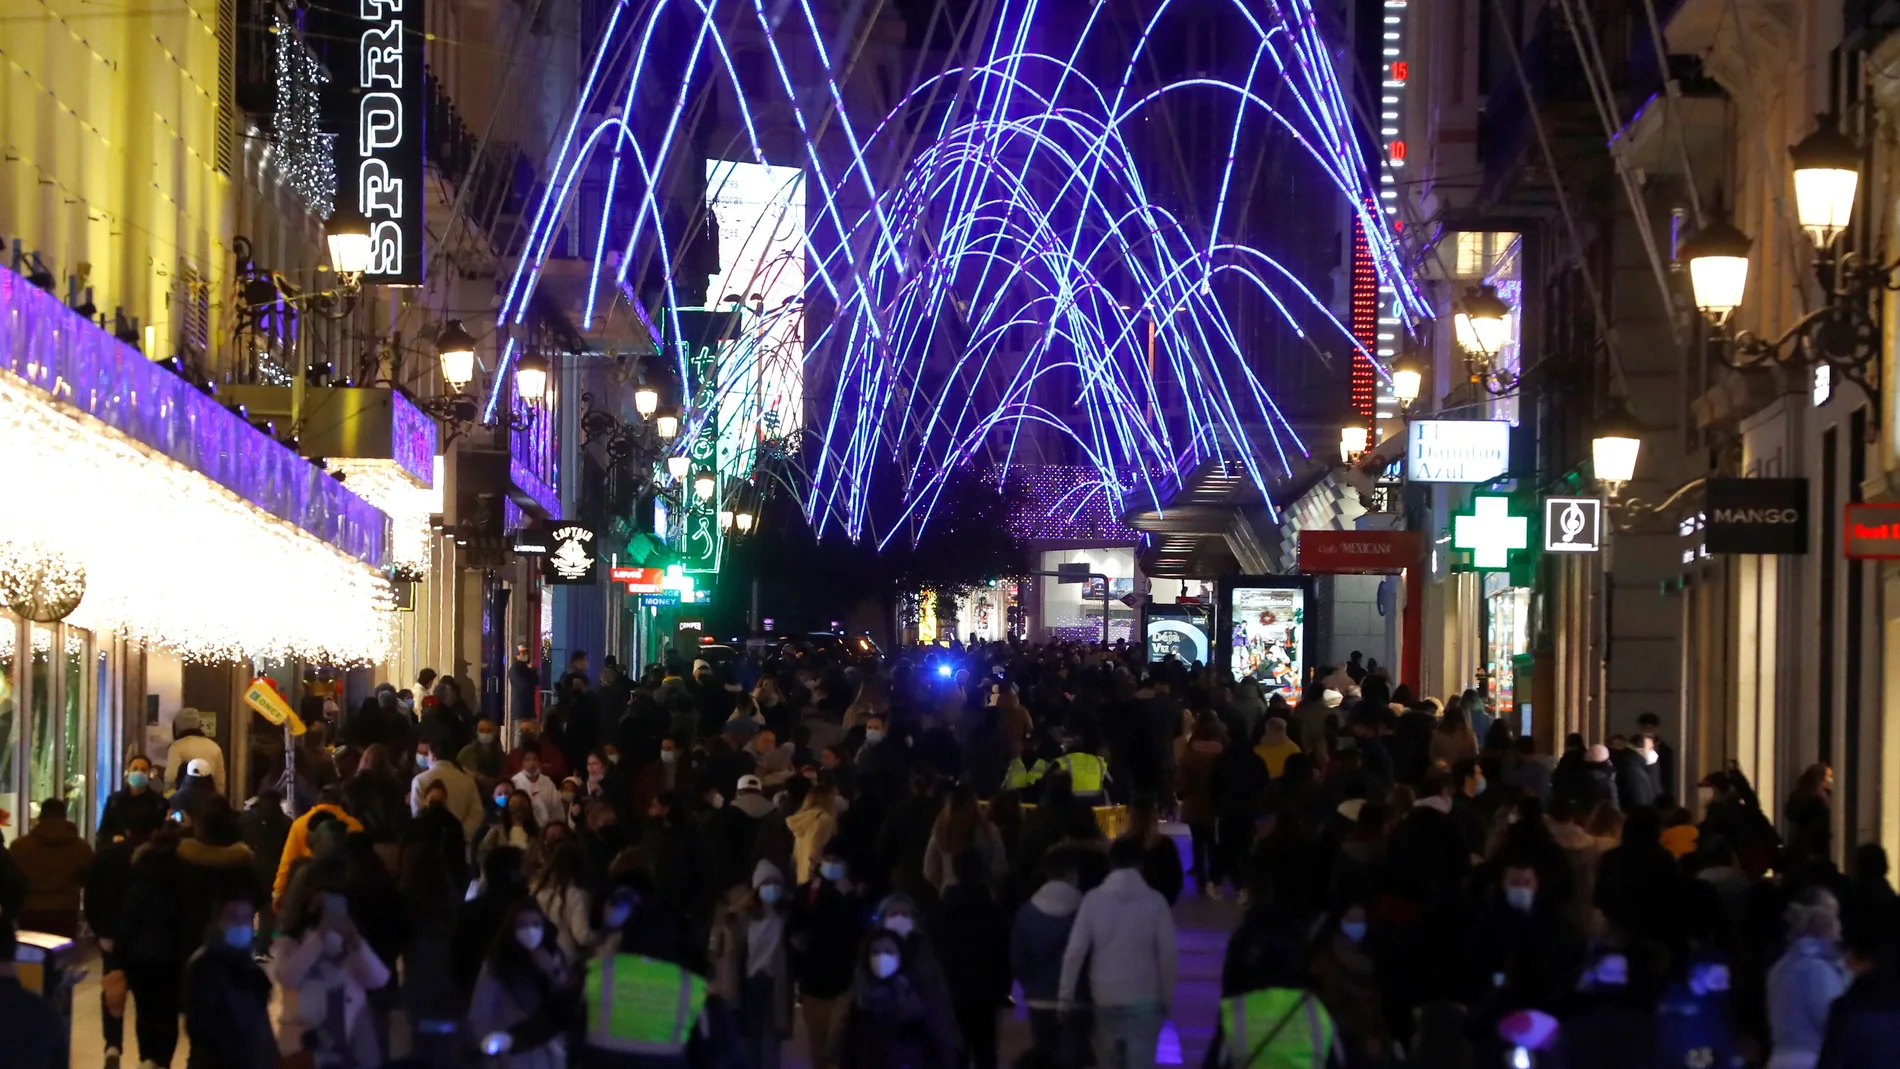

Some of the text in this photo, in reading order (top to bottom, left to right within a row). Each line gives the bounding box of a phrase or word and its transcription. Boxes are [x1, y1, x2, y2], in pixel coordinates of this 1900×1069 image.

[1391, 62, 1408, 81] 15
[1389, 141, 1407, 160] 10
[1417, 423, 1439, 440] El
[1416, 462, 1464, 479] Azul
[1714, 508, 1799, 523] MANGO
[1151, 642, 1170, 653] Vu
